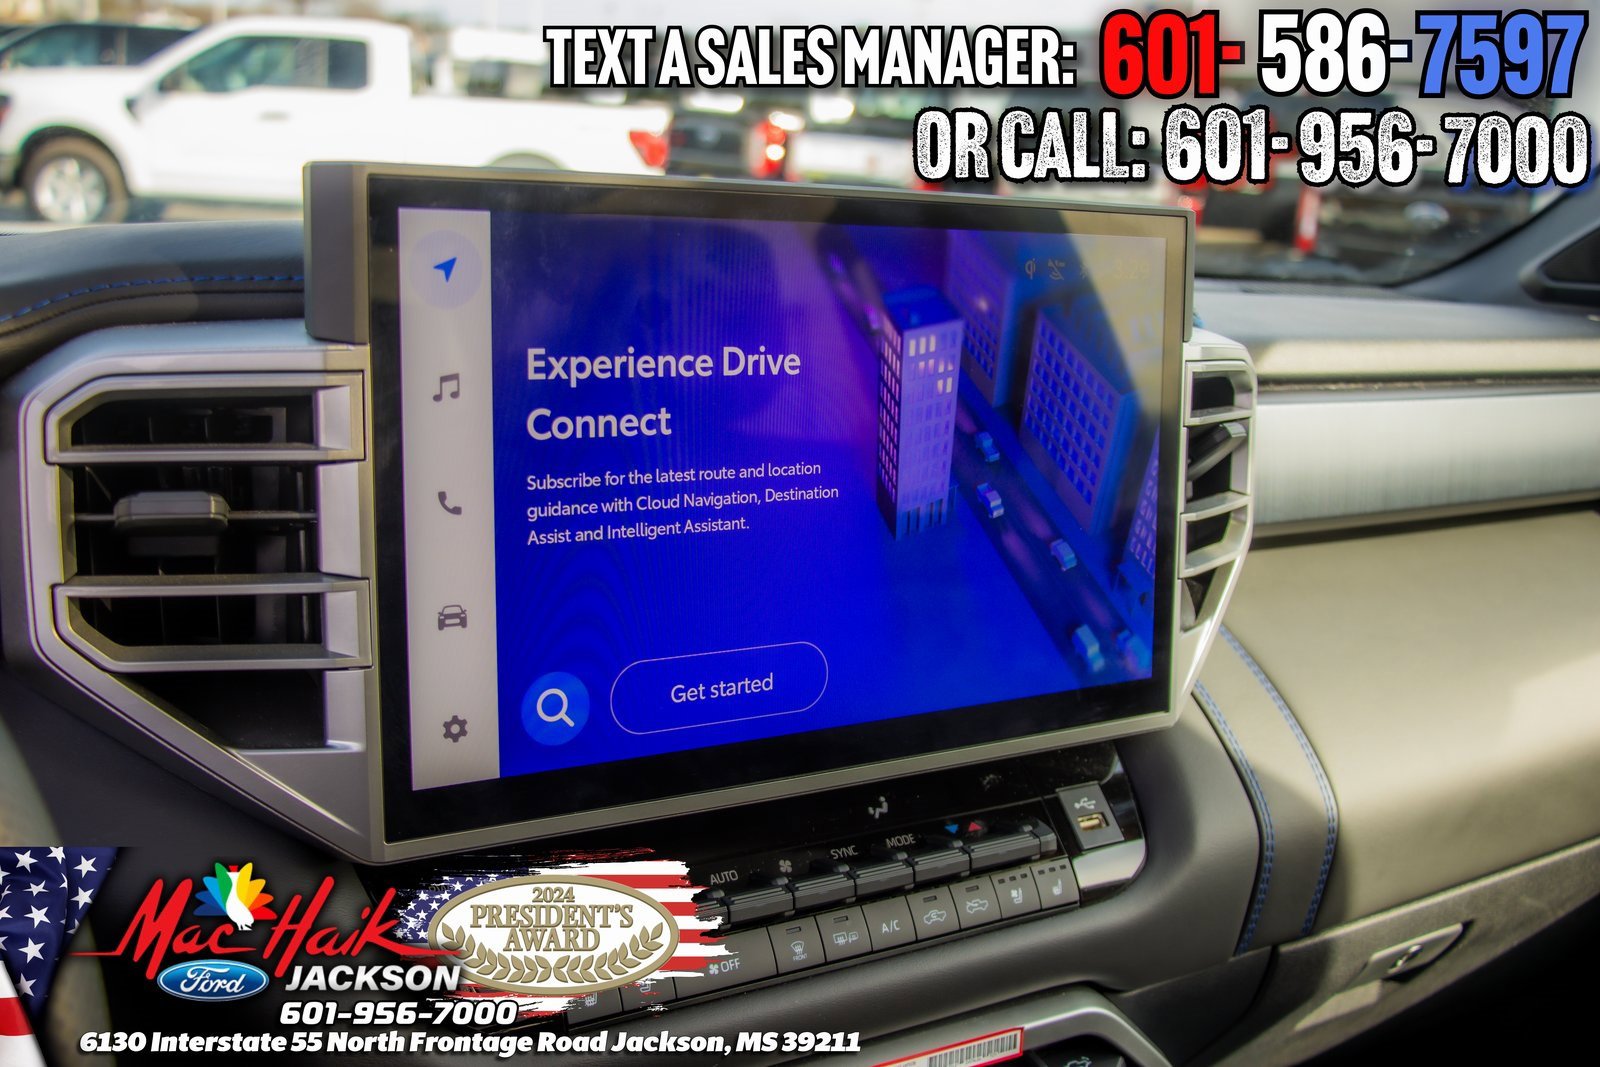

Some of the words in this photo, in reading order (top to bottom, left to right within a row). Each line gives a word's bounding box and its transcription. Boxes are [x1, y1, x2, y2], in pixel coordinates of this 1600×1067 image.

[526, 346, 714, 387] Experience
[722, 345, 801, 377] Drive
[526, 406, 672, 440] Connect
[526, 472, 601, 490] Subscribe
[604, 470, 626, 487] for
[628, 469, 653, 485] the
[655, 467, 696, 483] latest
[698, 465, 736, 480] route
[738, 462, 765, 479] and
[768, 461, 821, 477] location
[526, 500, 598, 522] guidance
[601, 495, 633, 513] with
[636, 493, 680, 511] Cloud
[683, 490, 762, 510] Navigation,
[764, 486, 839, 503] Destination
[527, 528, 571, 546] Assist
[575, 526, 603, 542] and
[607, 520, 681, 540] Intelligent
[683, 517, 750, 535] Assistant.
[670, 683, 706, 704] Get
[710, 672, 774, 699] started
[830, 844, 858, 860] SYNC
[886, 833, 916, 849] MODE
[710, 869, 739, 886] AUTO
[882, 919, 900, 934] A/C
[721, 958, 741, 973] OFF
